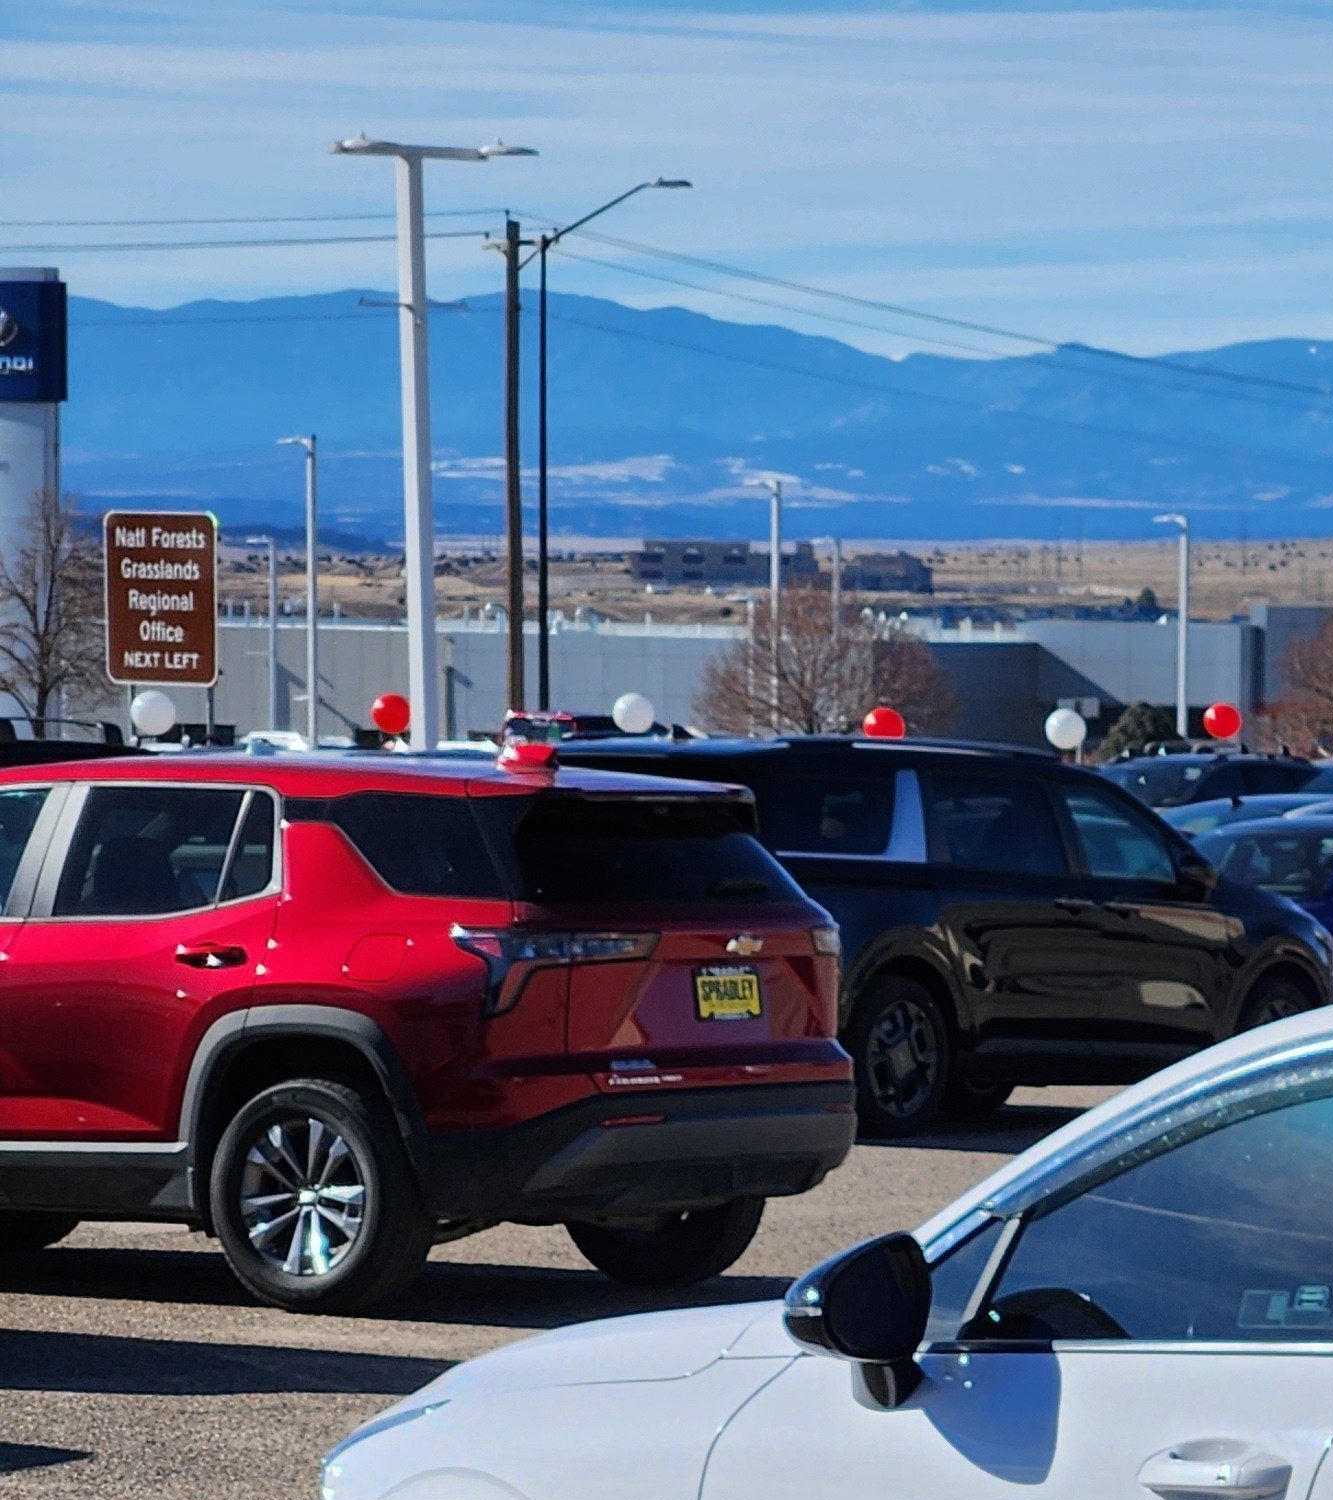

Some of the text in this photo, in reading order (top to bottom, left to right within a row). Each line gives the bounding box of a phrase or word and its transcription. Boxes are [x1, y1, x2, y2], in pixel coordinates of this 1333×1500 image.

[115, 526, 206, 549] Natl Forests
[120, 557, 200, 580] Grasslands
[128, 589, 194, 616] Regional
[139, 620, 184, 643] Office
[123, 652, 199, 670] NEXT LEFT
